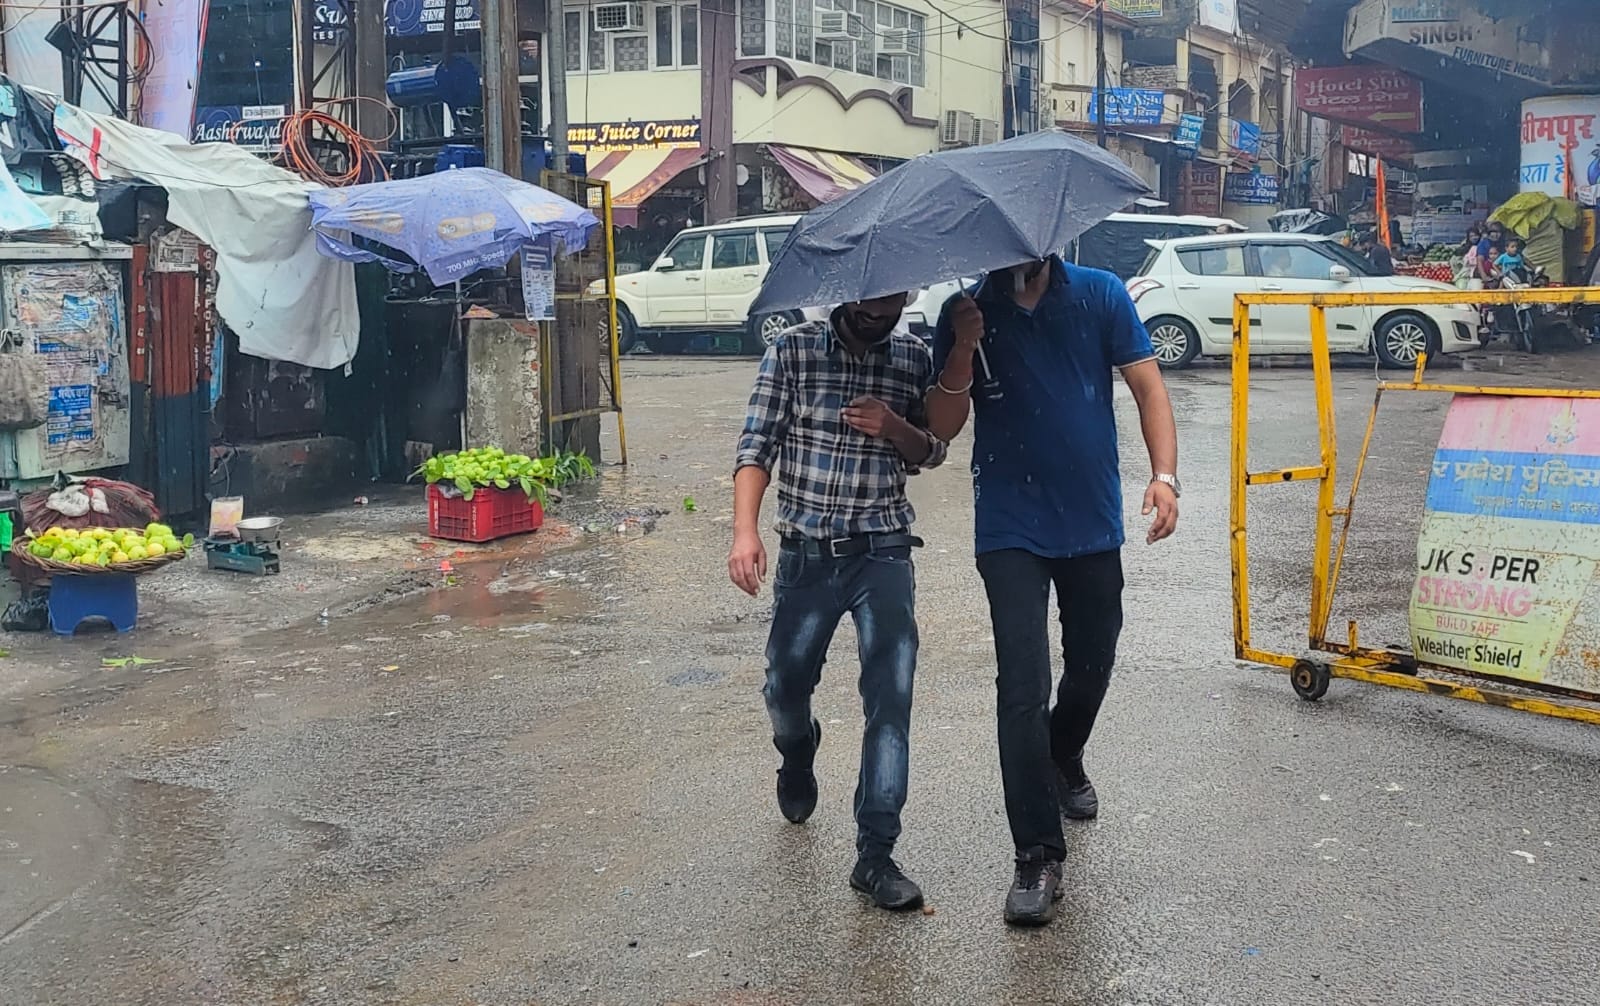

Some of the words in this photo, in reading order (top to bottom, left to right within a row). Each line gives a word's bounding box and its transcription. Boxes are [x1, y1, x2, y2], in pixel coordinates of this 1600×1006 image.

[1409, 25, 1474, 45] SINGH
[1453, 46, 1511, 72] FURNITURE
[1303, 78, 1362, 95] Hotel
[567, 128, 597, 141] nnu
[598, 122, 640, 143] Juice
[643, 121, 699, 141] Corner
[1520, 163, 1550, 184] रता
[446, 262, 462, 274] 700
[1454, 456, 1516, 483] प्रदेश
[1521, 458, 1600, 493] पुलिस
[1420, 548, 1454, 574] JK
[1417, 575, 1532, 617] STRONG
[1436, 615, 1468, 632] BUILD
[1471, 620, 1501, 636] SAFE
[1416, 634, 1472, 660] Weather
[1474, 644, 1522, 669] Shield
